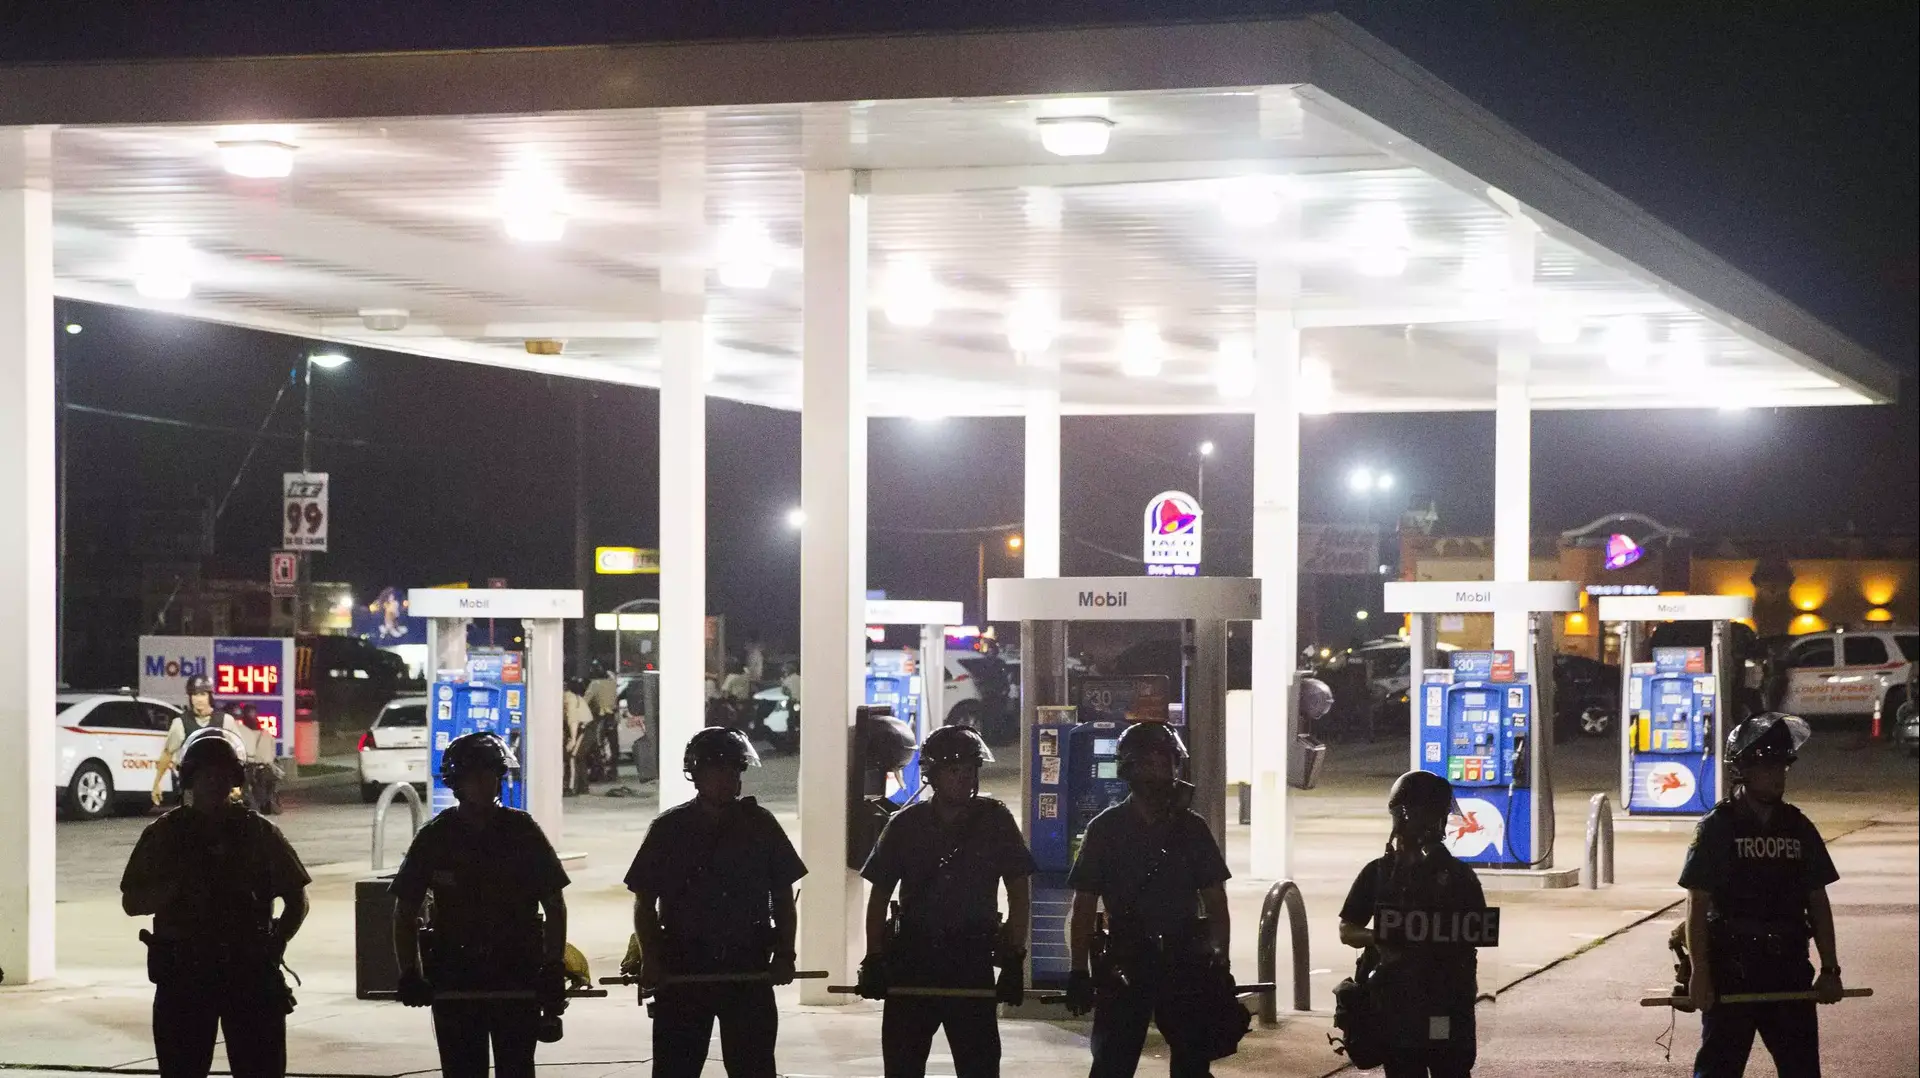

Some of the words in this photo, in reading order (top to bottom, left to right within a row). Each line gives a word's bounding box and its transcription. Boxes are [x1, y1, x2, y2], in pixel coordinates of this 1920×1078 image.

[287, 502, 323, 534] 99
[459, 599, 489, 608] Mobil
[1078, 591, 1127, 606] Mobil
[1455, 592, 1491, 602] Mobil
[1657, 604, 1685, 612] Mobil
[146, 655, 207, 676] Mobil
[1735, 837, 1801, 859] TROOPER
[1379, 909, 1498, 943] POLICE
